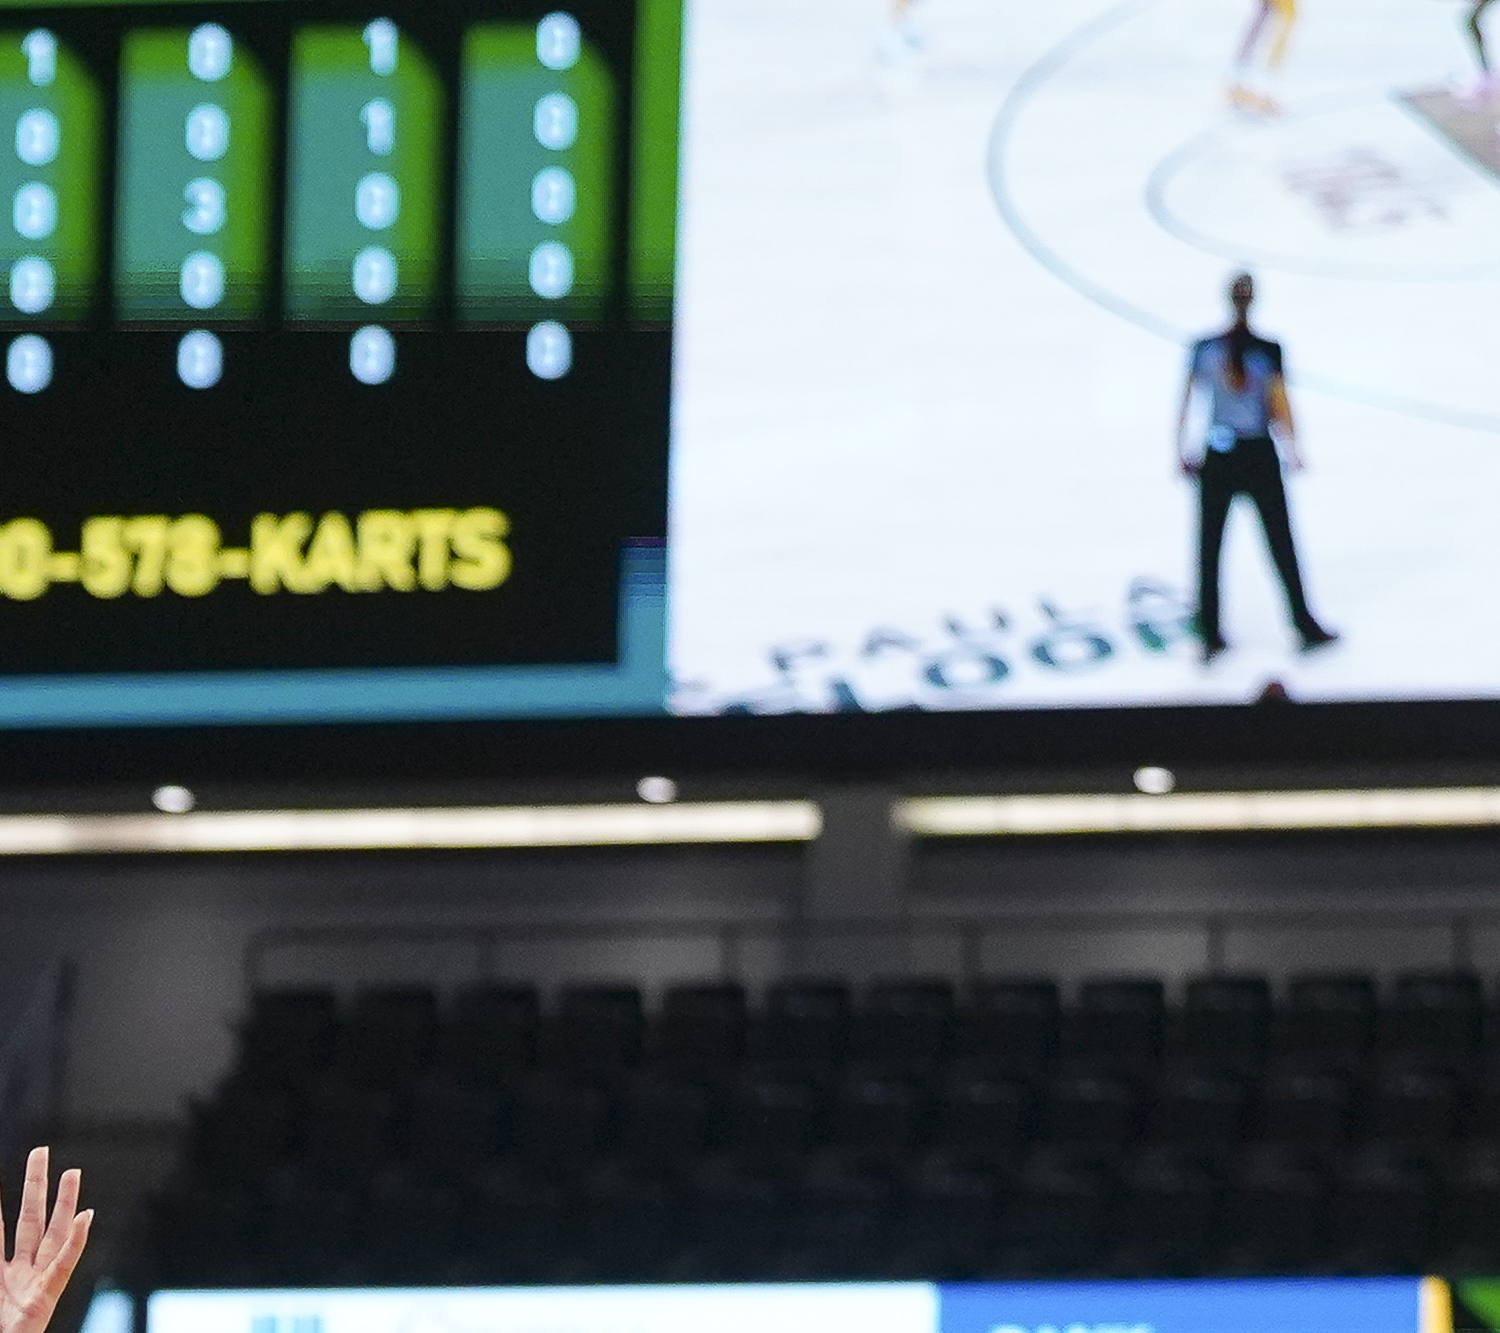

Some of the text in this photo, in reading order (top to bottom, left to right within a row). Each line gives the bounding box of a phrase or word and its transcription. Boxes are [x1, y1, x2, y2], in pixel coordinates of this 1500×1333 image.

[22, 30, 57, 87] 1
[187, 24, 232, 82] 0
[363, 18, 398, 76] 1
[535, 13, 580, 71] 0
[15, 109, 58, 164] 0
[186, 105, 228, 160] 0
[362, 99, 394, 155] 1
[534, 93, 576, 149] 0
[12, 182, 55, 238] 0
[184, 178, 225, 234] 3
[355, 173, 397, 229] 0
[531, 167, 573, 224] 0
[10, 242, 573, 314] 0 0 0 0
[7, 334, 52, 394] 0
[177, 330, 223, 390] 0
[349, 325, 395, 385] 0
[526, 320, 572, 380] 0
